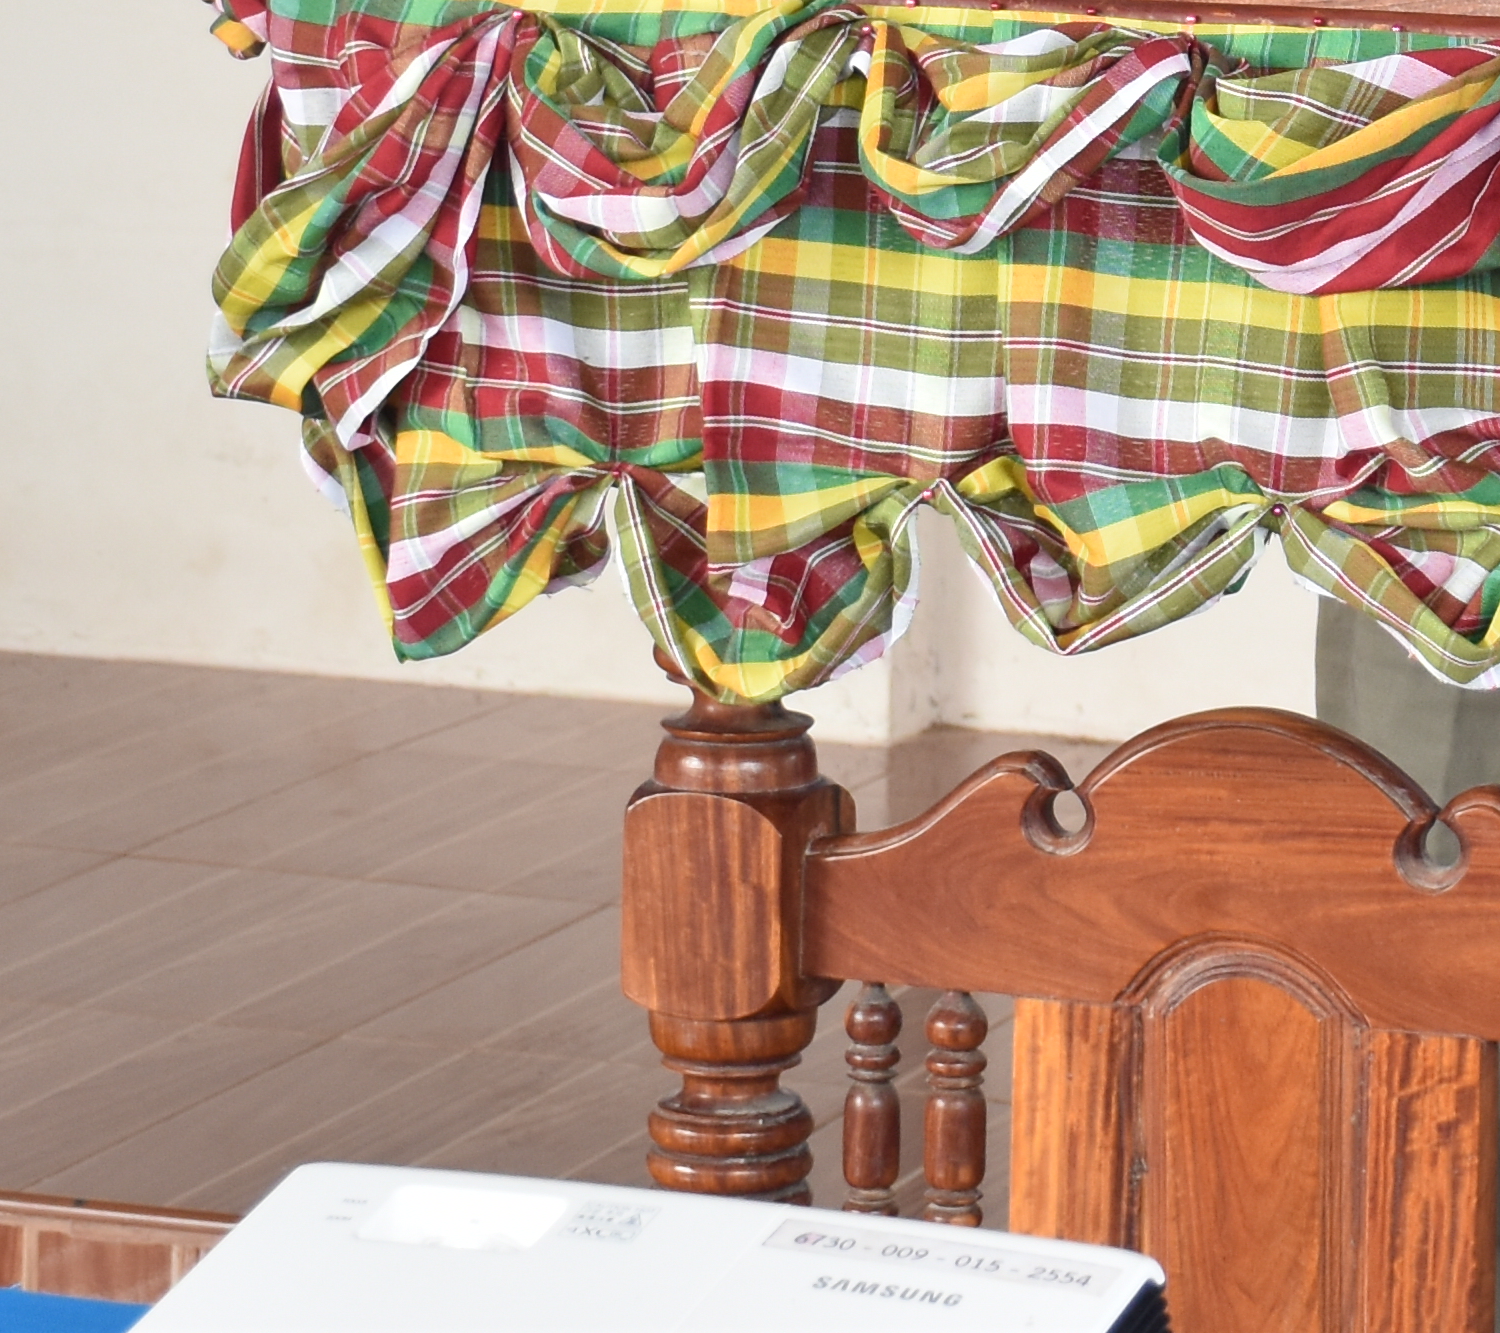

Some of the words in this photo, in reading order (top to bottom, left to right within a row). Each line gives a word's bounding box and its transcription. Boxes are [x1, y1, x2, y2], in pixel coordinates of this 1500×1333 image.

[794, 1232, 856, 1251] 6730
[882, 1244, 929, 1261] 009
[954, 1254, 1000, 1272] 015
[1028, 1266, 1092, 1287] 2554
[812, 1275, 962, 1307] SAMSUNG
